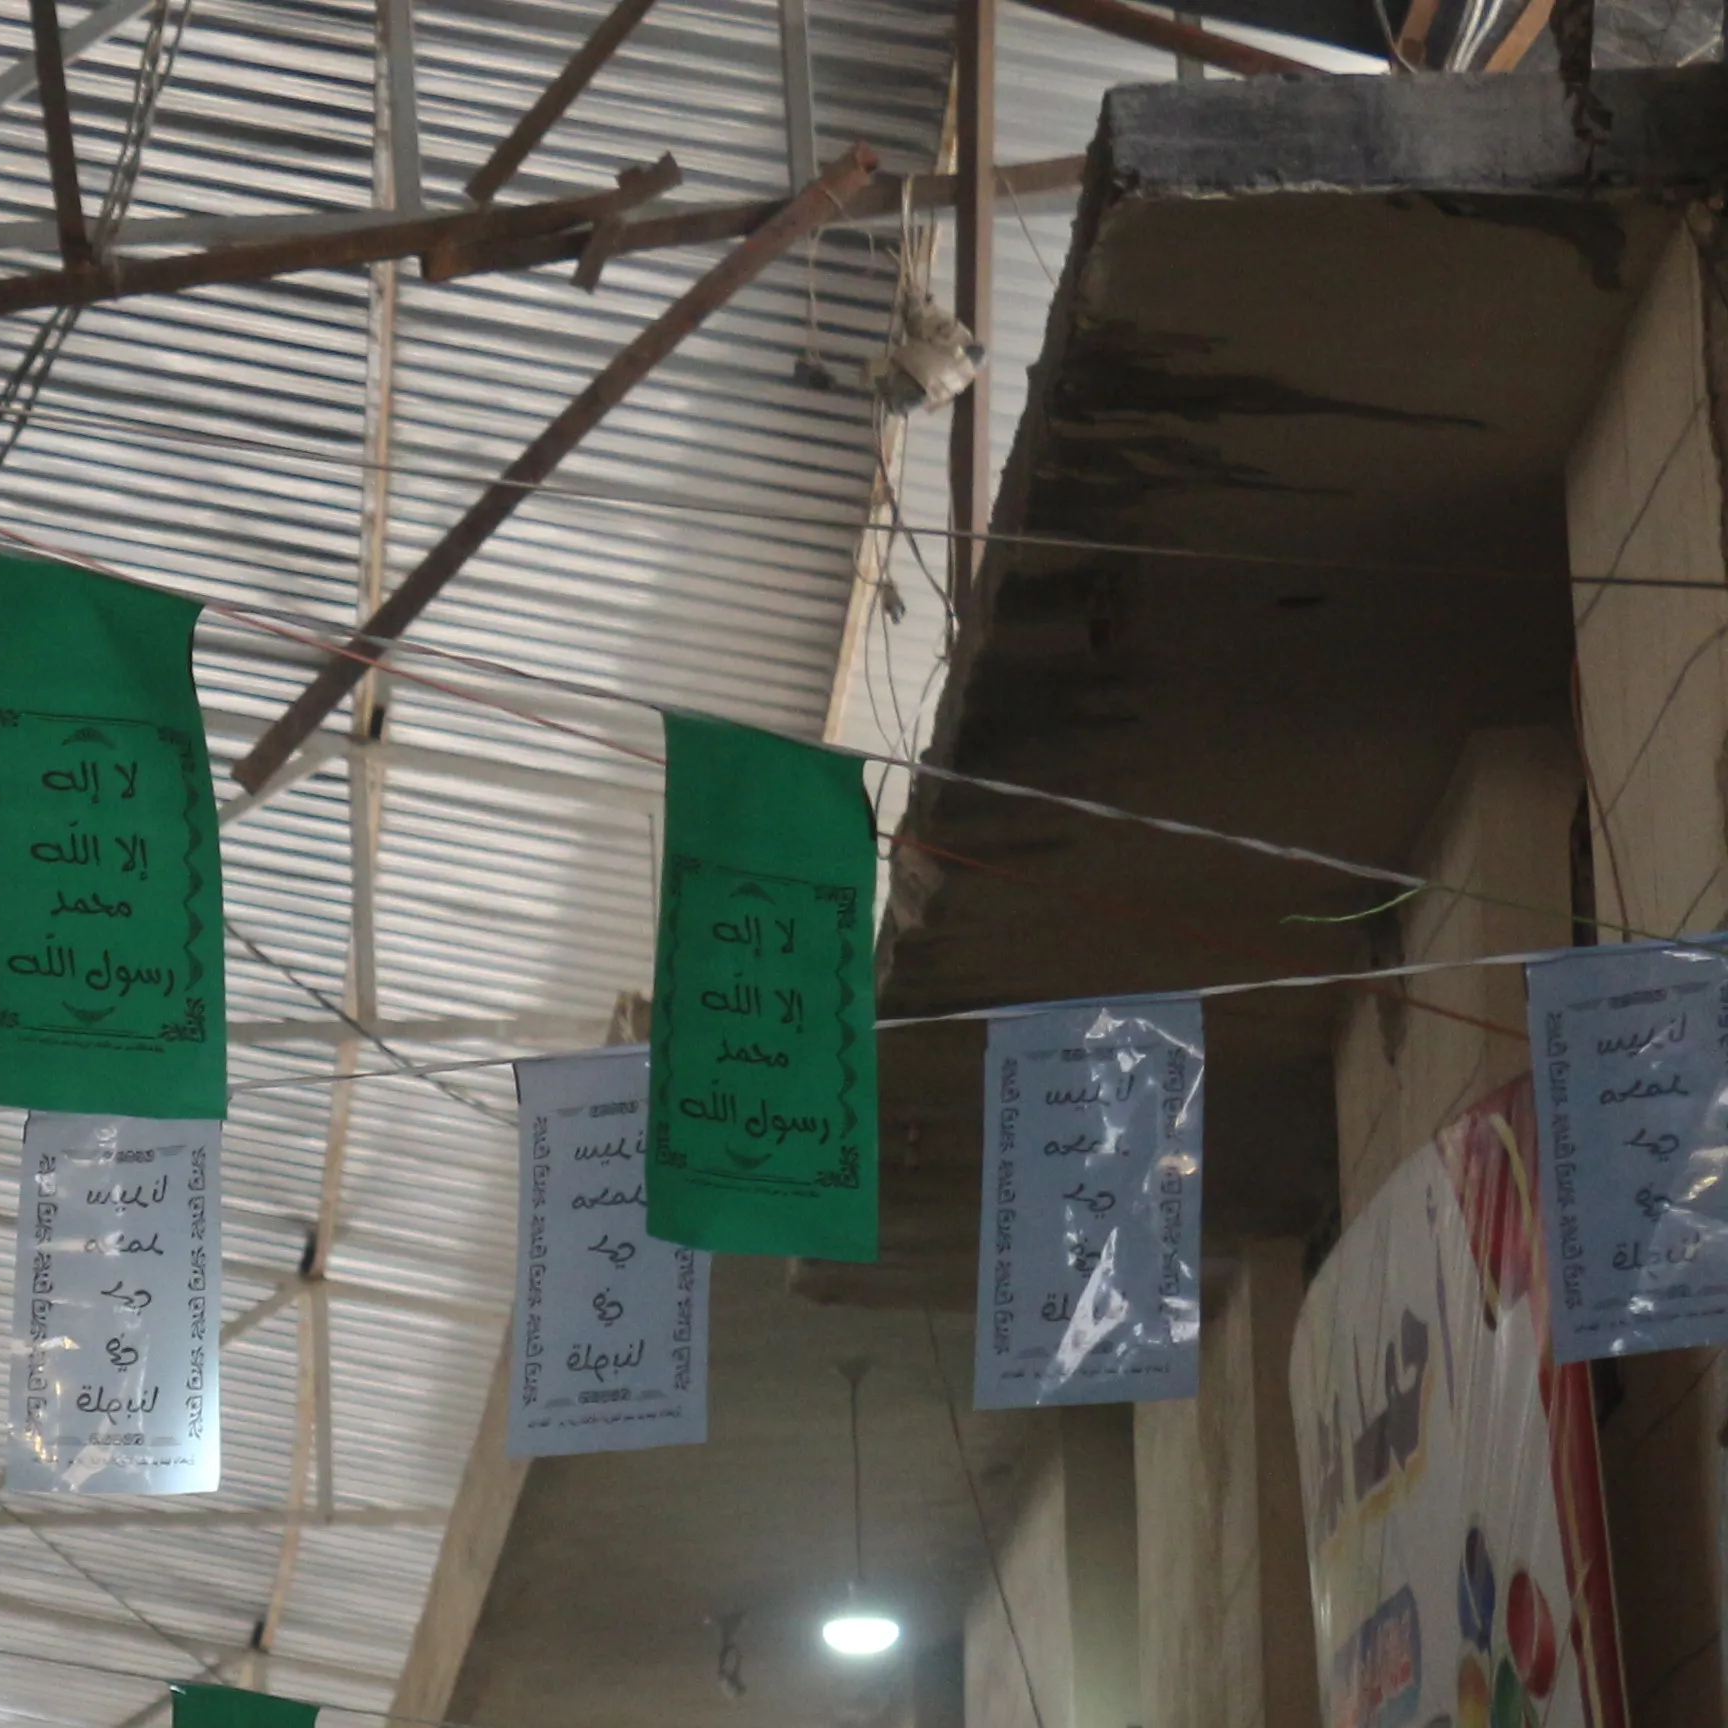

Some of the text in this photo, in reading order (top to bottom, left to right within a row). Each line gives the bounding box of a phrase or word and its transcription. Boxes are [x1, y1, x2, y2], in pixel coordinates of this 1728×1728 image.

[114, 761, 138, 800] لا
[30, 821, 101, 866] الله
[50, 890, 132, 918] محمد
[775, 918, 796, 954] لا
[6, 935, 174, 998] رسول الله
[701, 970, 762, 1017] الله
[716, 1038, 789, 1069] محمد
[678, 1079, 830, 1145] رسول الله
